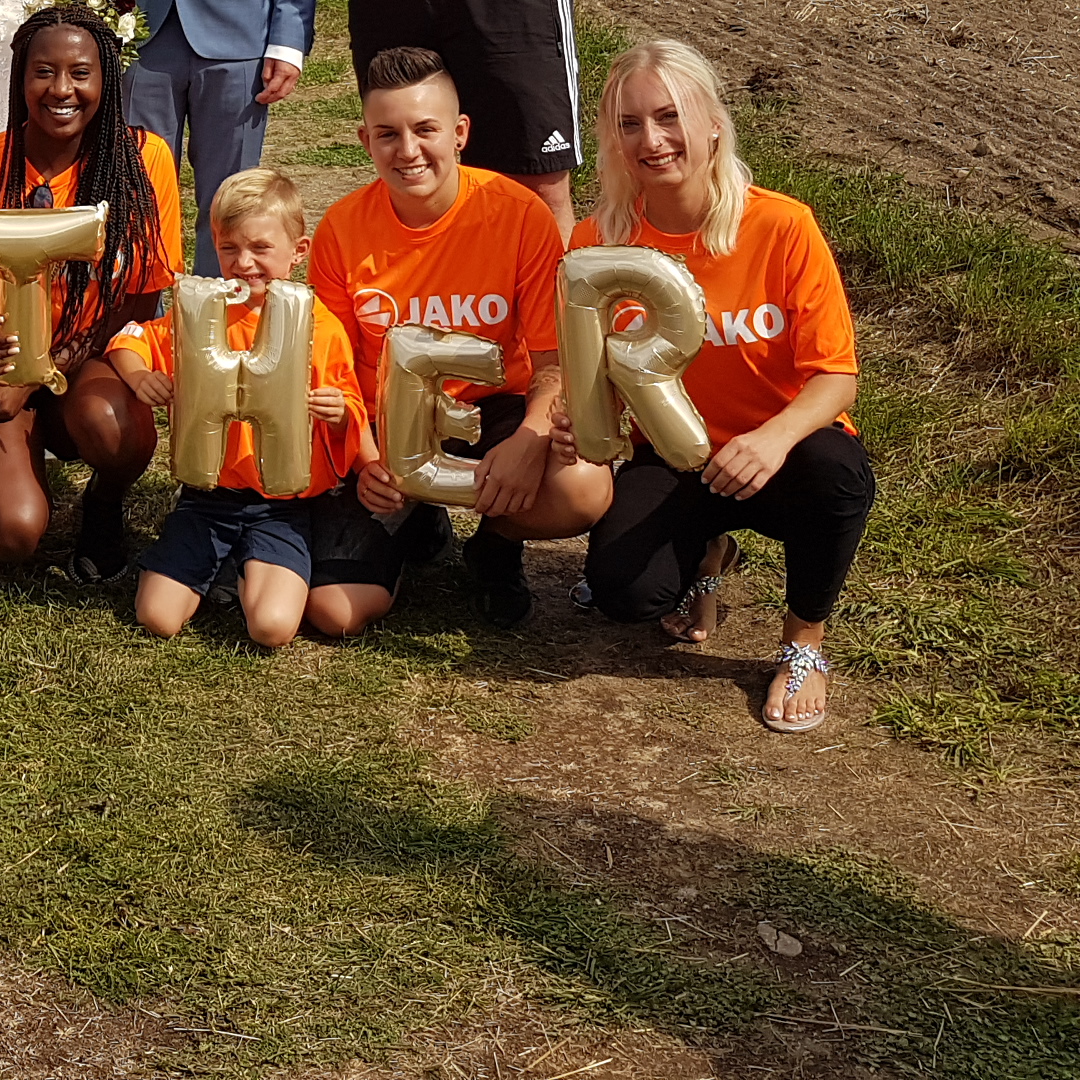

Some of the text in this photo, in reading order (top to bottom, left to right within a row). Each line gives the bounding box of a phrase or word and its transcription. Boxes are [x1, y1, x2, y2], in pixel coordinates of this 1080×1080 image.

[541, 142, 571, 153] adidas
[403, 293, 508, 327] JAKO
[704, 303, 785, 347] AKO
